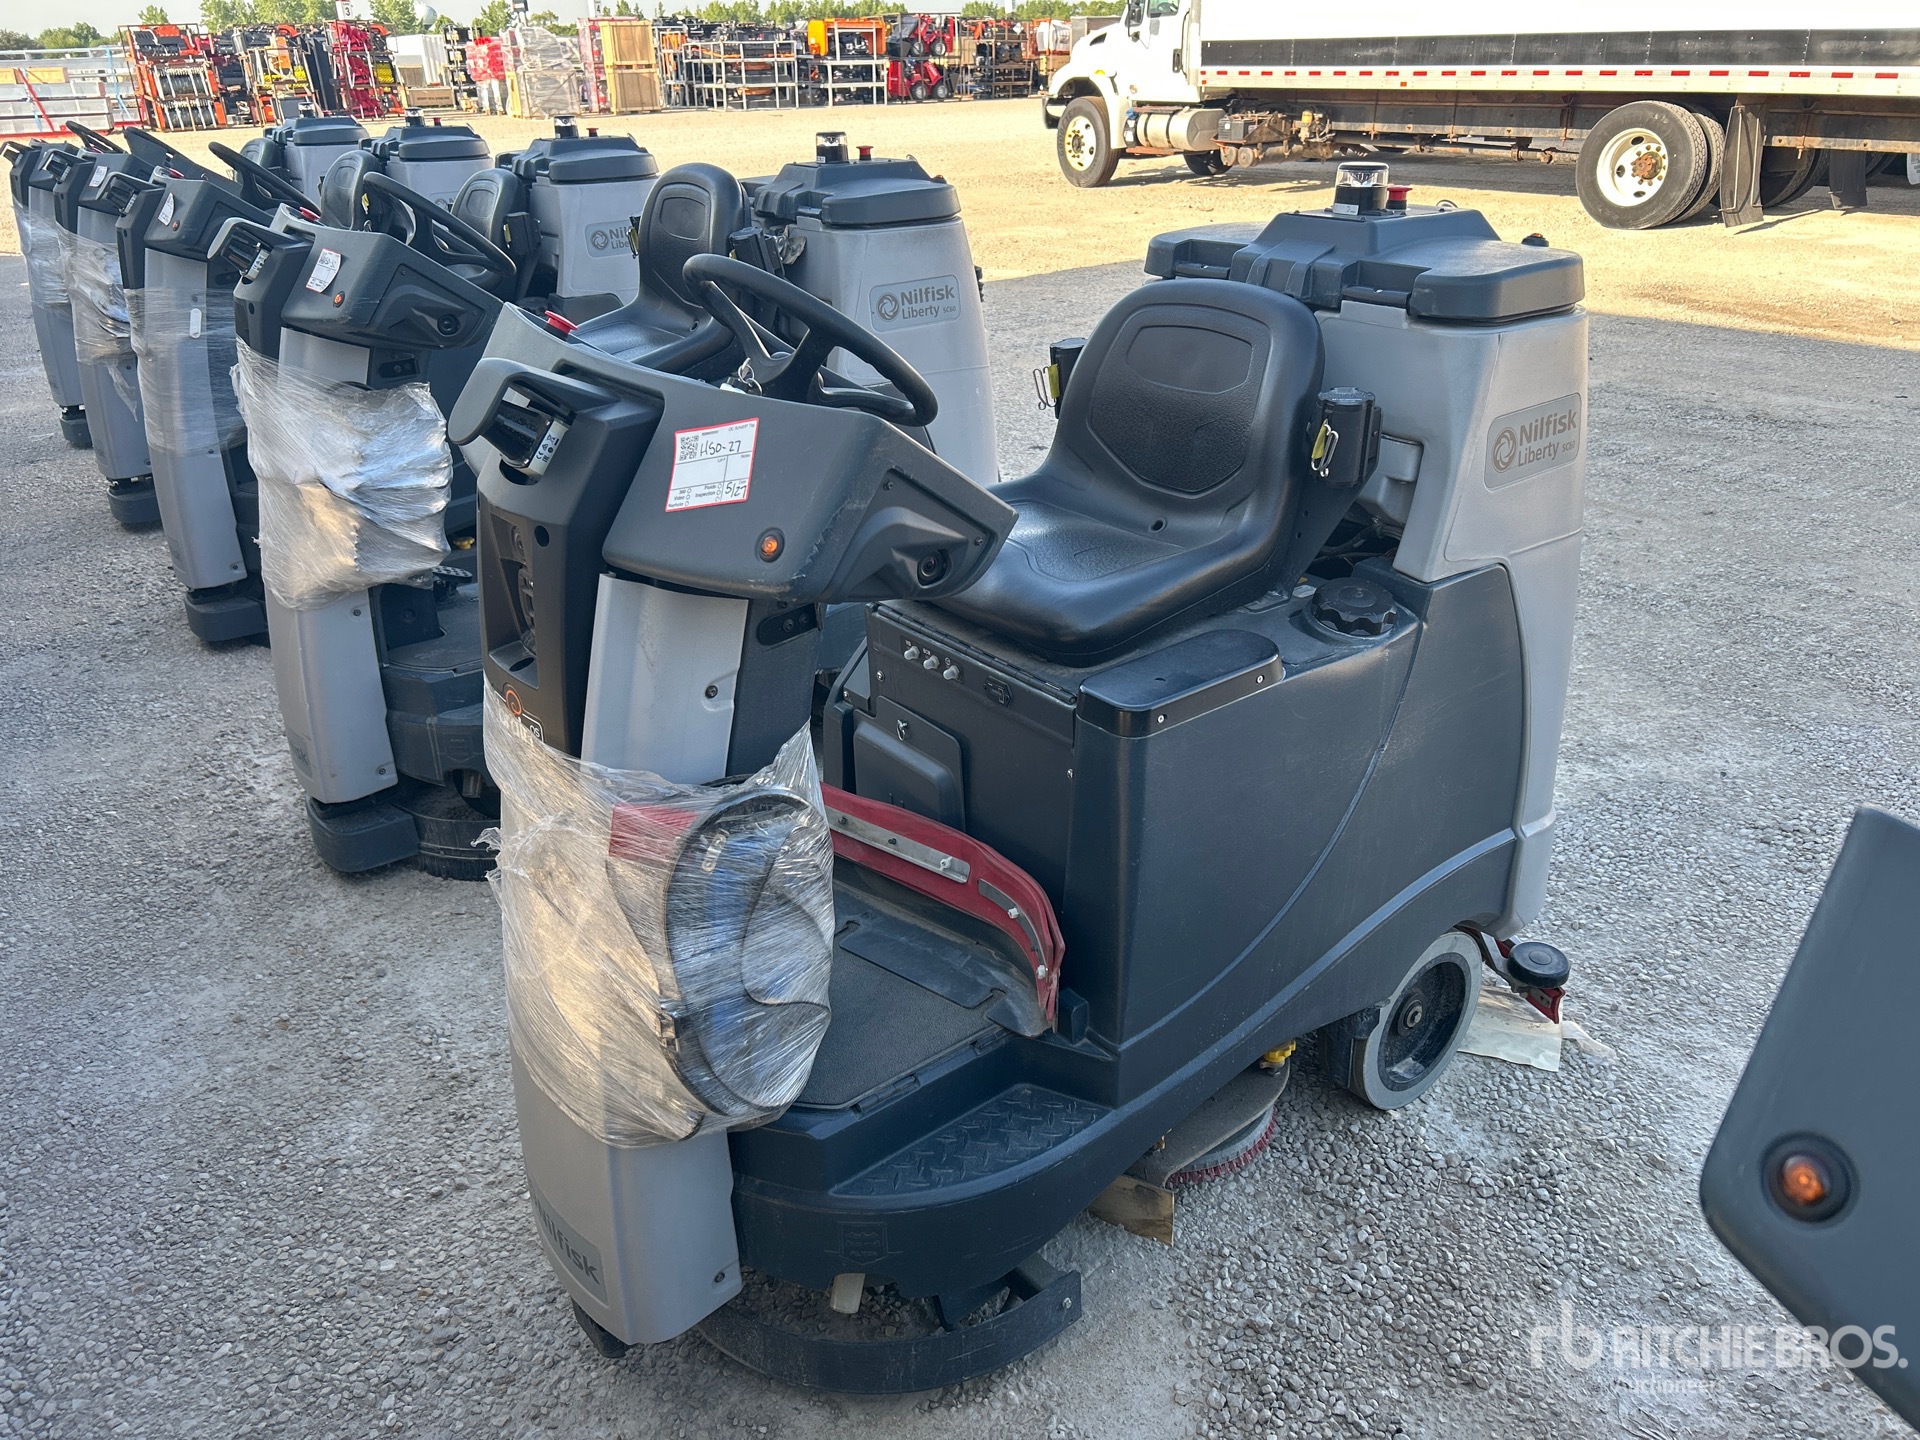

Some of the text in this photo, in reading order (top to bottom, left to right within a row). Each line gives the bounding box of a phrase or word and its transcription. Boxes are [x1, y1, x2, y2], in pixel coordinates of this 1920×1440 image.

[344, 7, 351, 16] 3
[900, 285, 955, 306] Nilfisk
[901, 305, 940, 320] Liberty
[1519, 408, 1577, 447] Nilfisk
[1517, 442, 1560, 467] Liberty
